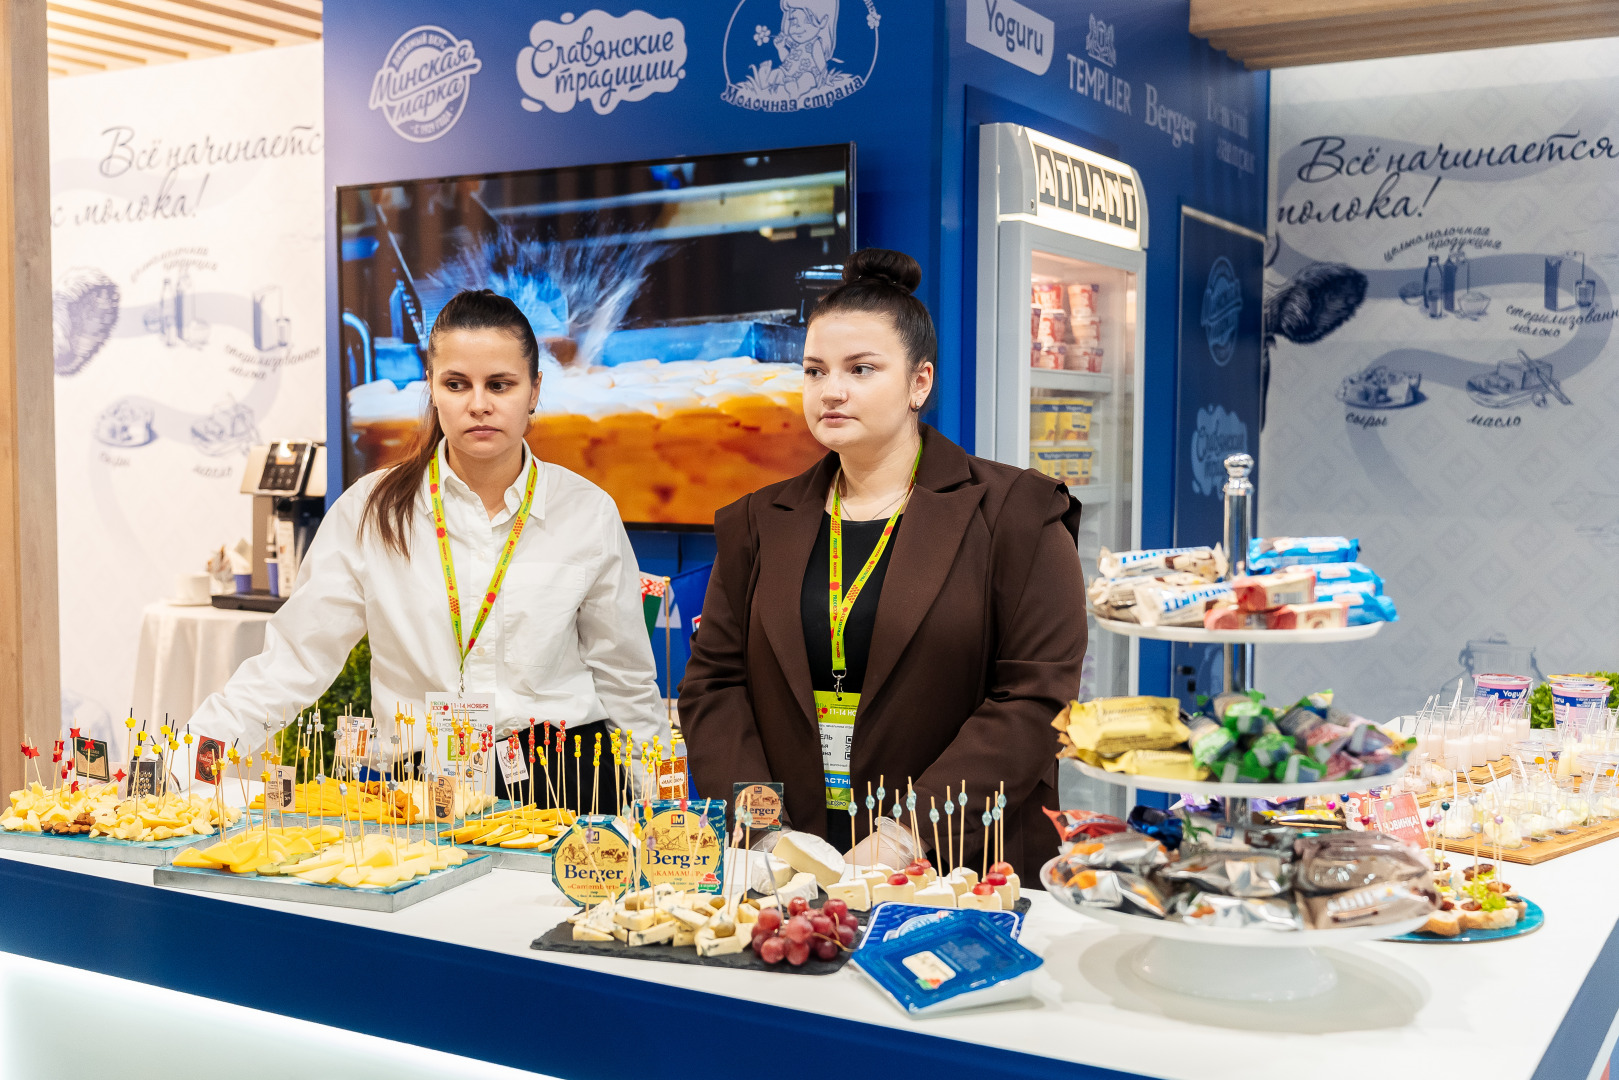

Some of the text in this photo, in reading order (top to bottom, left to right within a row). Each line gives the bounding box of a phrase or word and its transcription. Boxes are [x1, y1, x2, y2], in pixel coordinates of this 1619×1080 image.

[532, 26, 674, 78] Славянские
[985, 0, 1044, 57] Yoguru
[372, 44, 471, 105] Минская
[397, 78, 461, 118] марка
[555, 60, 679, 107] традиции
[726, 77, 864, 112] Молочная страна
[1066, 53, 1132, 116] TEMPLIER
[1144, 84, 1197, 148] Berger
[99, 126, 161, 178] Всё
[1297, 135, 1380, 183] Всё
[1386, 130, 1619, 174] начинается
[74, 172, 210, 227] молока!
[1038, 152, 1136, 223] ATLANT
[1345, 412, 1387, 428] сыры
[1466, 412, 1521, 427] масло
[1502, 690, 1521, 699] Yogu
[1382, 814, 1420, 832] НОВИНКА!
[564, 863, 624, 883] Berger
[646, 849, 710, 869] Berger
